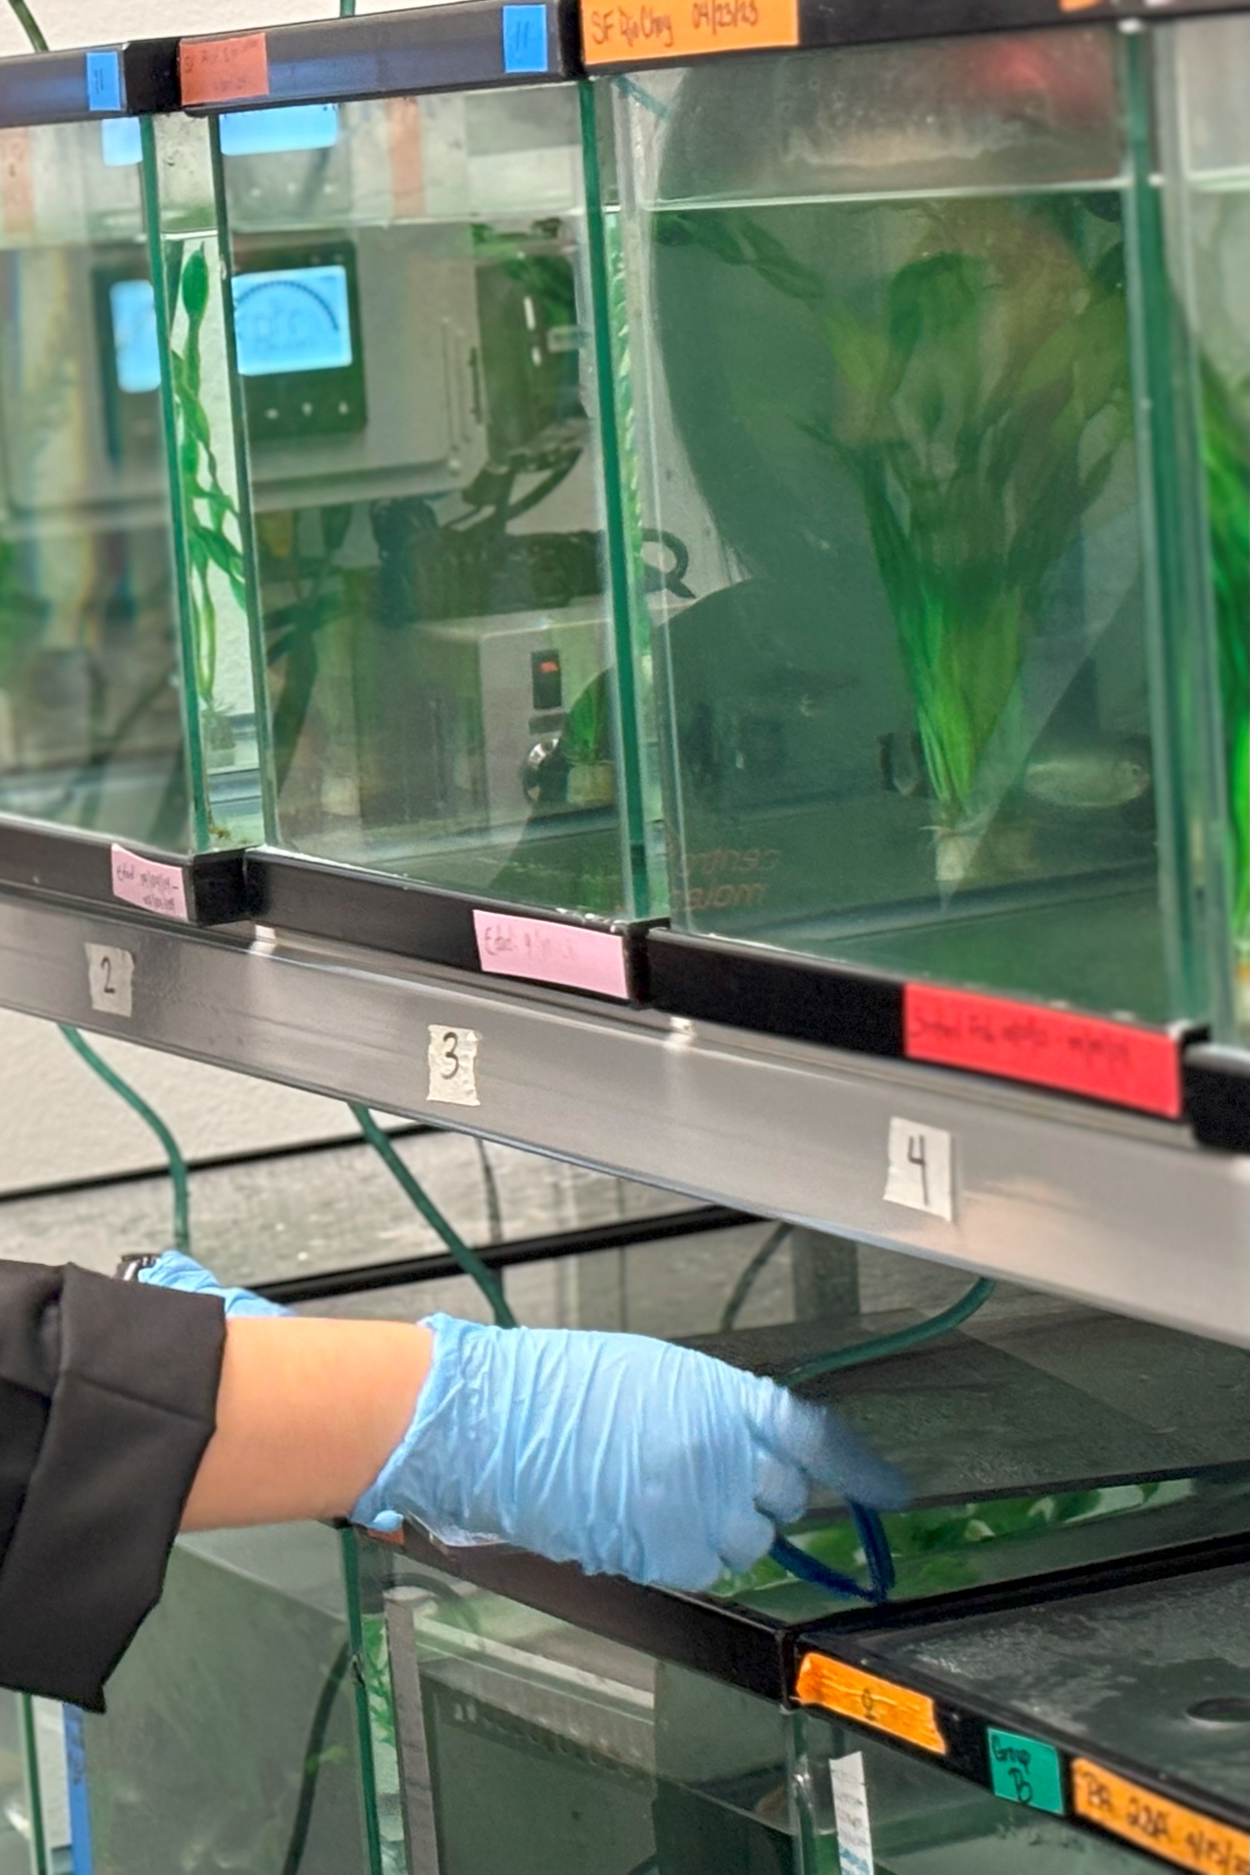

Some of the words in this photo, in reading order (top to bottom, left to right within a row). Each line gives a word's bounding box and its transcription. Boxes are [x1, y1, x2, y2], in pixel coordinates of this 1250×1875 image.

[100, 955, 116, 995] 2
[440, 1031, 460, 1080] 3
[907, 1134, 929, 1207] 4
[991, 1734, 1032, 1776] Group
